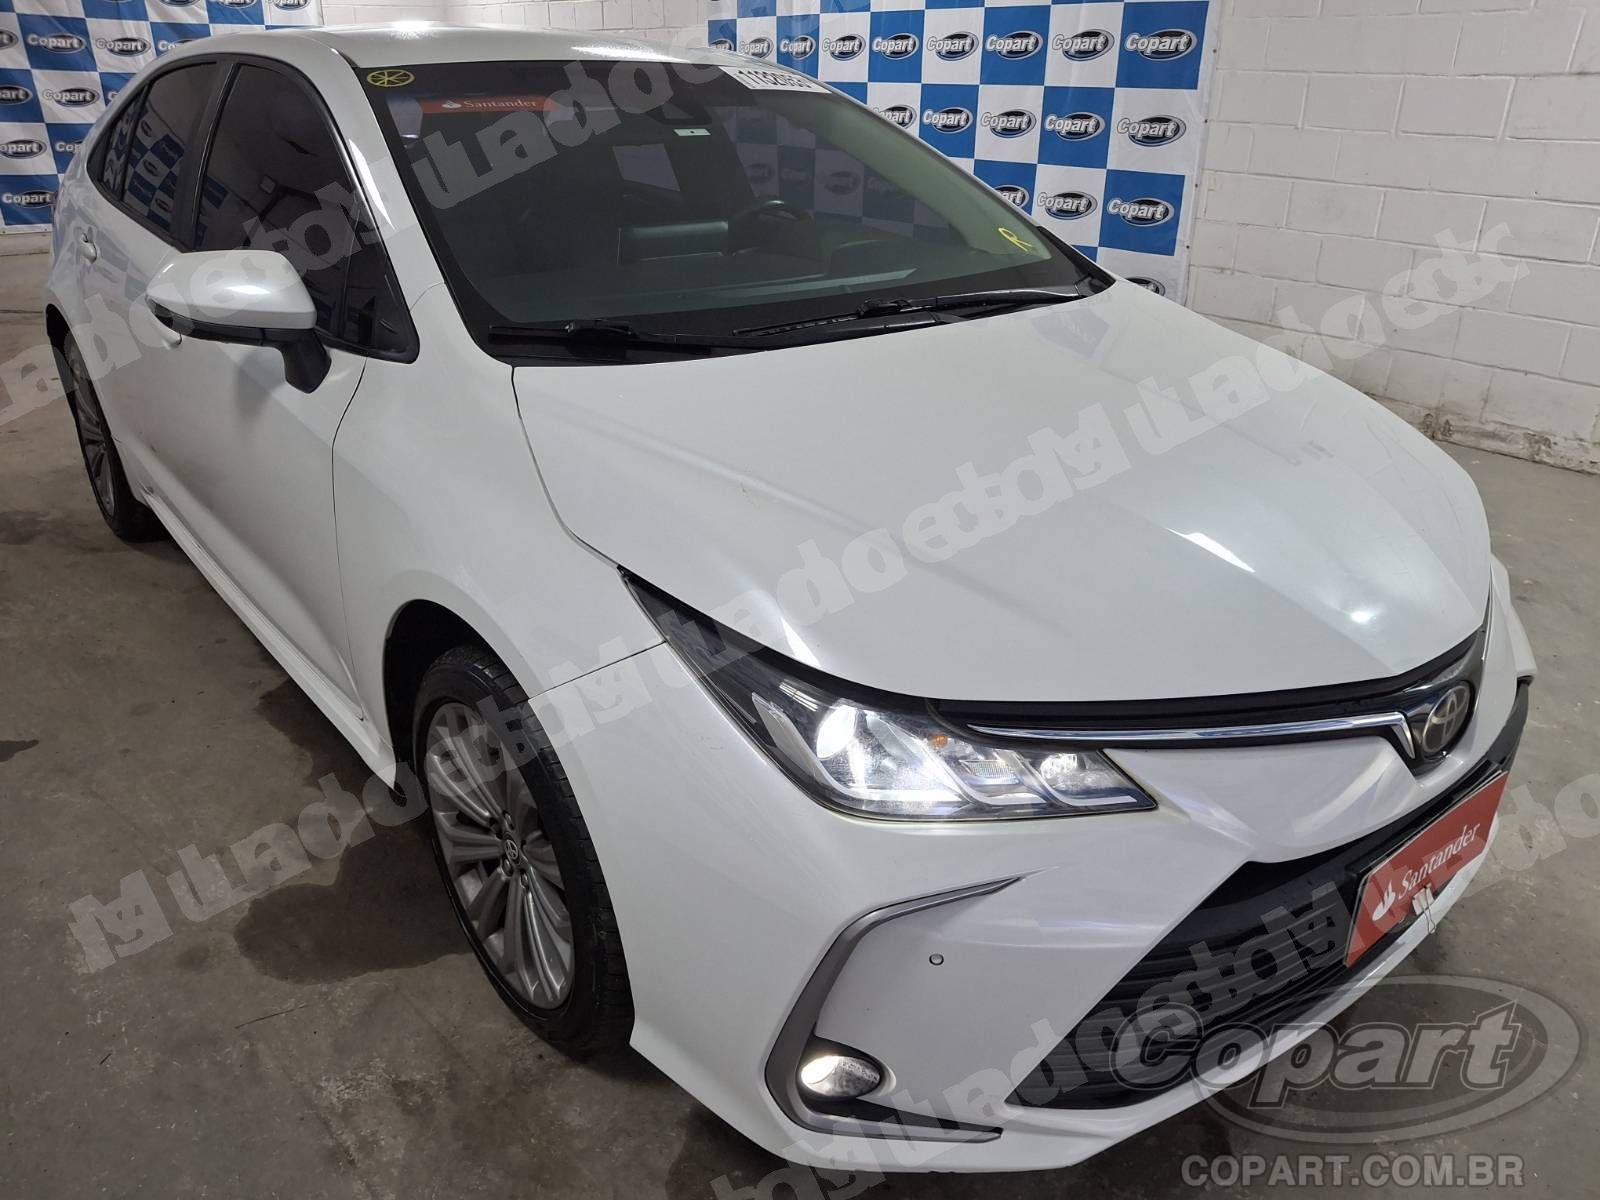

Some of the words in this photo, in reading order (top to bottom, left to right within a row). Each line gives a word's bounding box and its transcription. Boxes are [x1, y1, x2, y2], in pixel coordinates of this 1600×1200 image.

[27, 33, 80, 50] Copart
[95, 38, 144, 52] Copart
[740, 39, 769, 56] Copart
[780, 38, 812, 56] Copart
[822, 37, 863, 55] Copart
[873, 35, 913, 55] Copart
[927, 35, 972, 55] Copart
[986, 35, 1036, 53] Copart
[1052, 34, 1104, 54] Copart
[1125, 34, 1191, 56] Copart
[0, 88, 26, 100] art
[42, 88, 92, 102] Copart
[463, 98, 537, 109] Santander
[922, 108, 967, 128] Copart
[981, 111, 1029, 131] Copart
[1044, 114, 1096, 133] Copart
[1117, 117, 1175, 139] Copart
[0, 141, 40, 155] opart
[55, 141, 81, 154] Cop
[2, 191, 51, 205] Copart
[999, 190, 1024, 206] art
[1037, 191, 1088, 213] Copart
[1107, 198, 1166, 220] Copart
[1398, 822, 1481, 900] Santander
